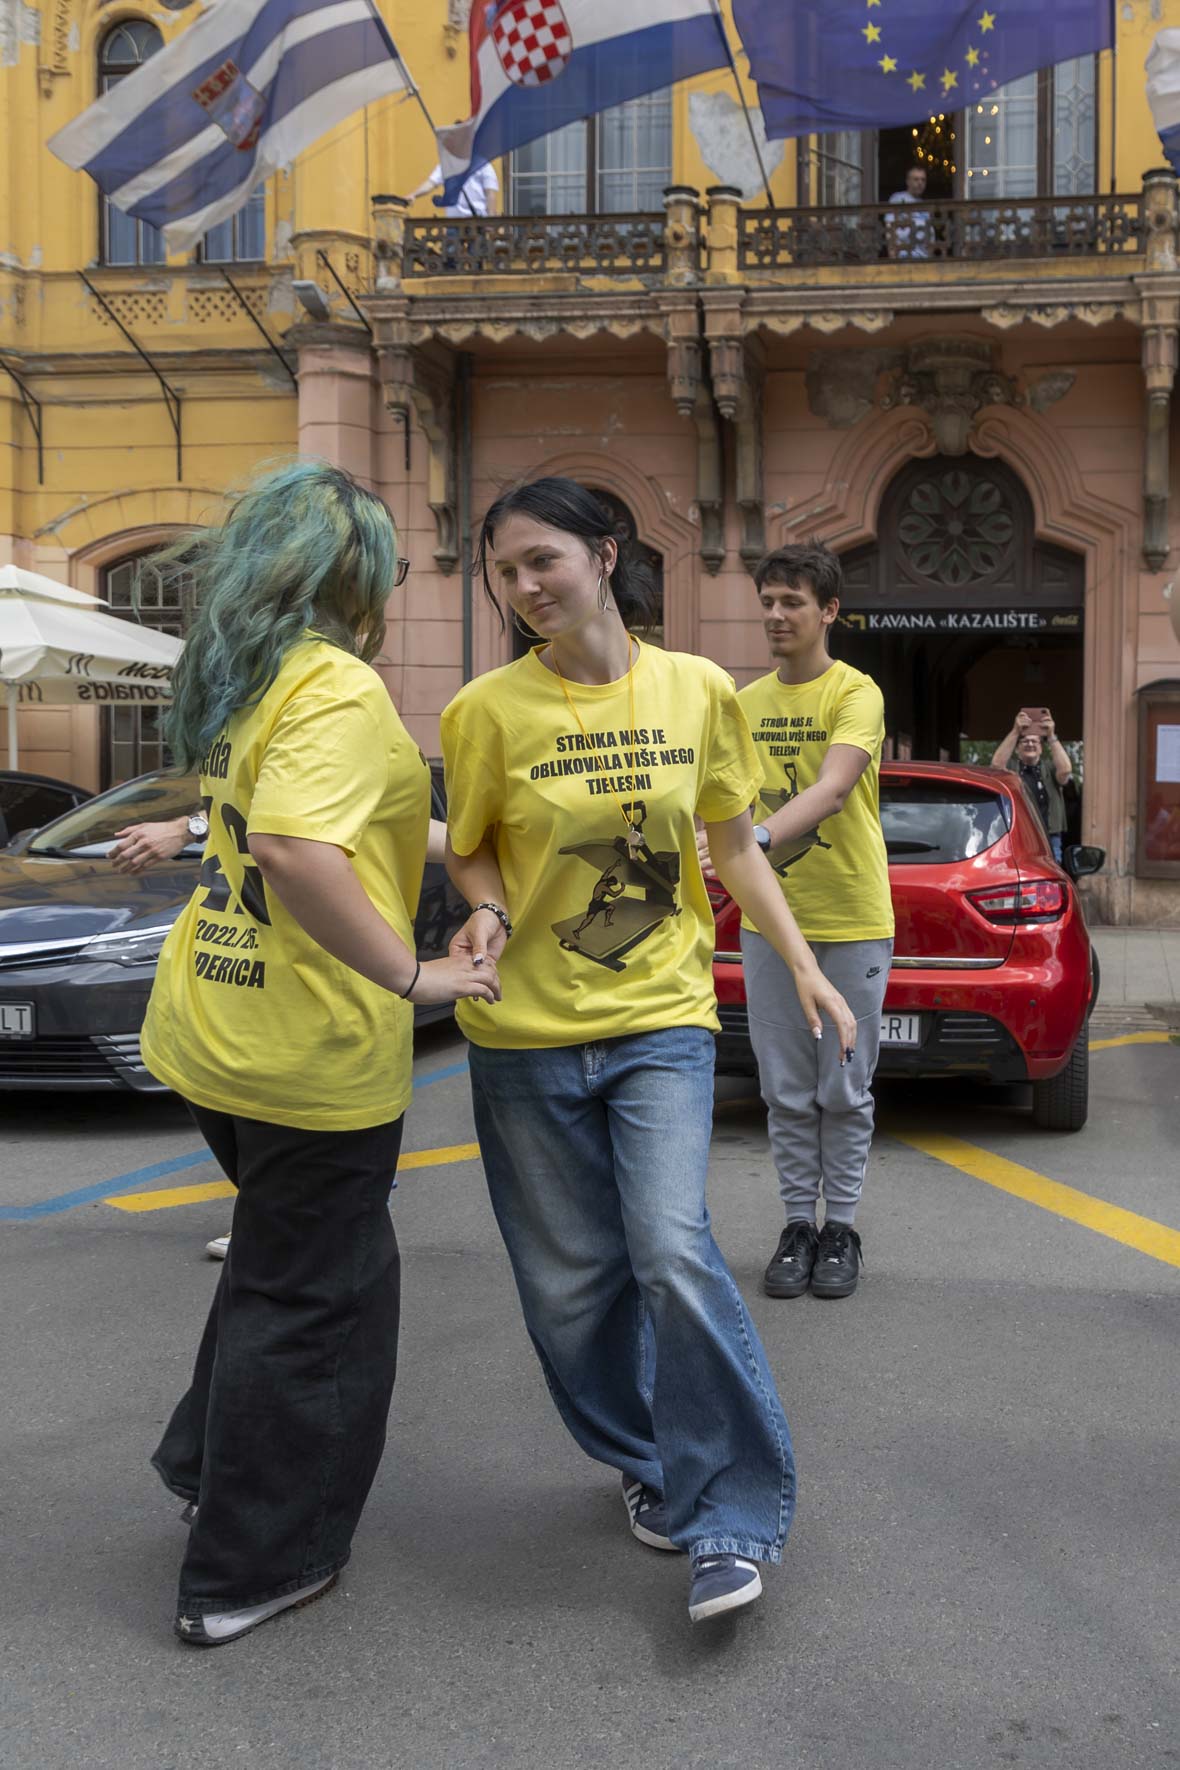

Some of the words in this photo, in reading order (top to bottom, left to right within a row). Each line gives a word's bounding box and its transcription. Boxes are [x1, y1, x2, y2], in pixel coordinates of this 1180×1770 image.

[869, 614, 936, 628] KAVANA
[790, 717, 804, 727] NAS
[805, 717, 813, 727] JE
[556, 731, 616, 752] STRUKA
[619, 729, 650, 745] NAS
[652, 729, 667, 745] JE
[806, 730, 827, 742] NEGO
[530, 753, 623, 780] OBLIKOVALA
[625, 748, 658, 770] VIŠE
[660, 748, 695, 766] NEGO
[586, 774, 652, 795] TJELESNI
[194, 951, 265, 989] DERICA
[2, 1008, 27, 1030] LT
